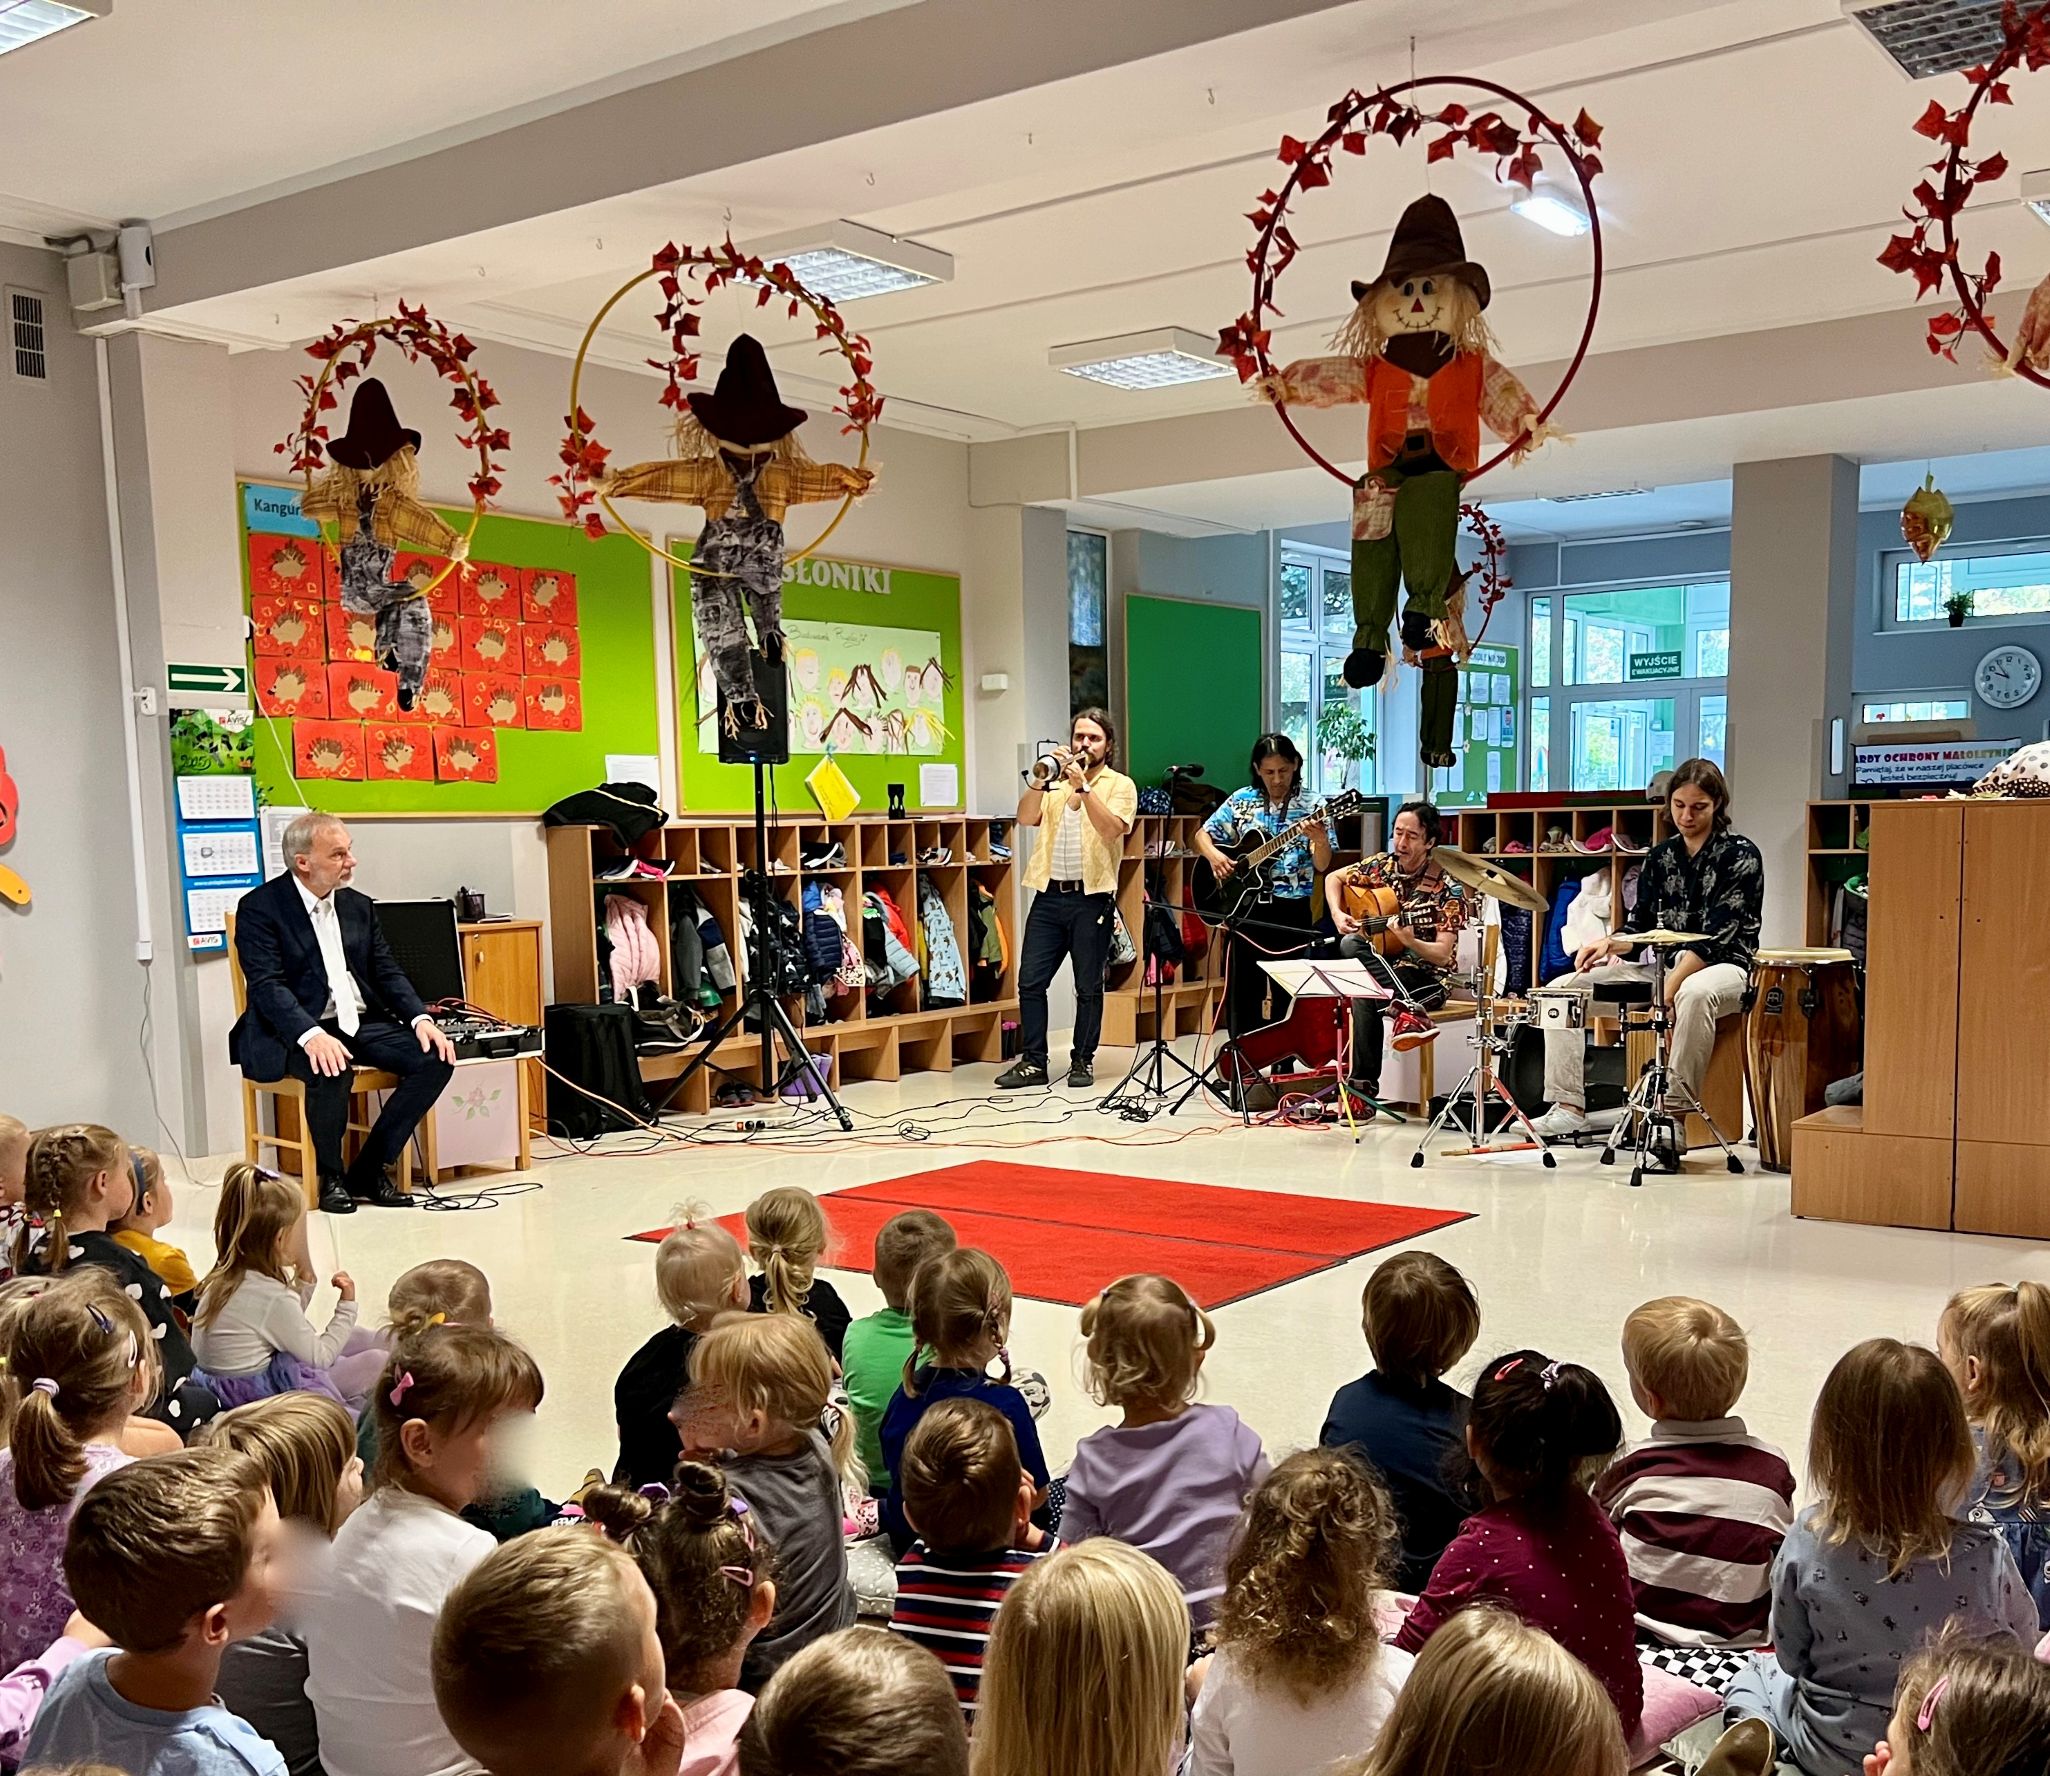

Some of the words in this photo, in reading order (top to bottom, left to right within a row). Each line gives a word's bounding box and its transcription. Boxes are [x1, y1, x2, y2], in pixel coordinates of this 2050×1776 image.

[783, 559, 891, 595] SŁONIKI
[1634, 655, 1678, 667] WYJŚCIE
[1884, 752, 1939, 763] OCHRONY
